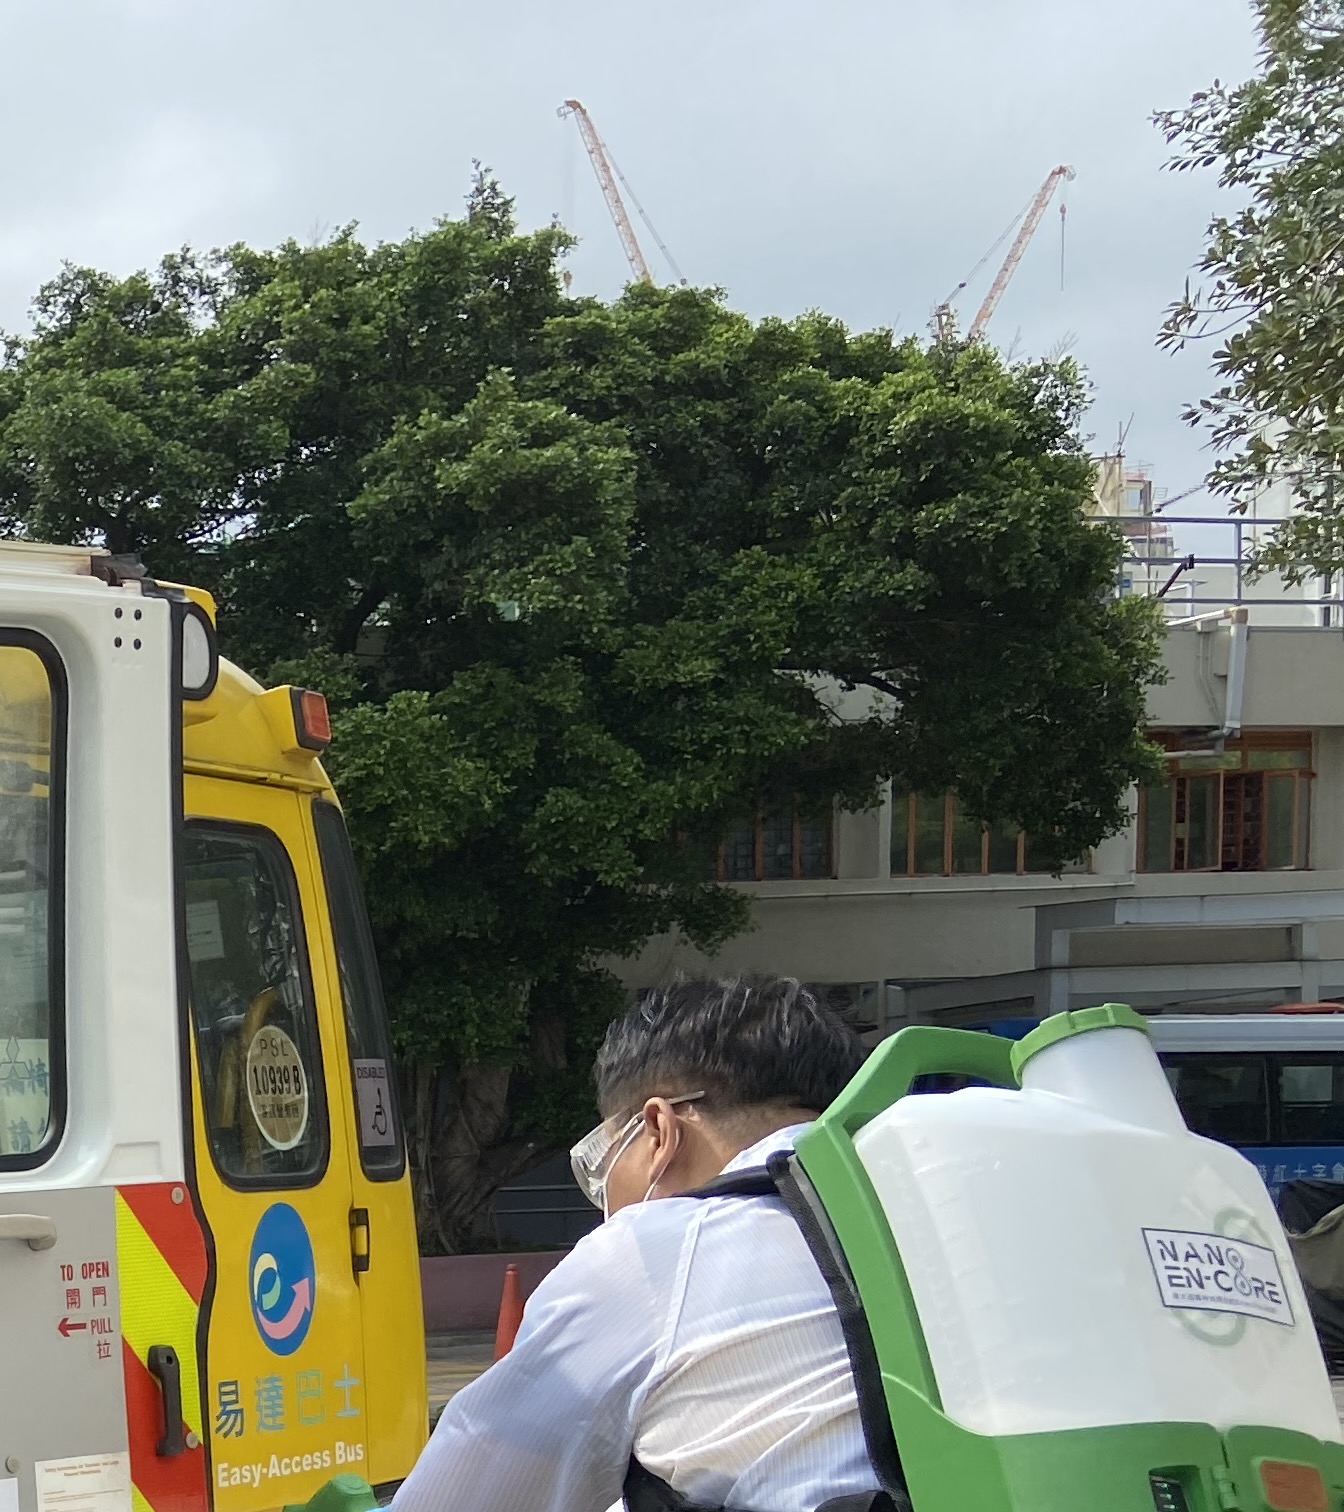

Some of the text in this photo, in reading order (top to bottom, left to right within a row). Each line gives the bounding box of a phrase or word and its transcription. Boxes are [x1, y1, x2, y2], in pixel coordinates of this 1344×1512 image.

[259, 1038, 289, 1057] PSL
[1156, 1239, 1244, 1272] NANO
[60, 1261, 110, 1281] TO OPEN
[1164, 1265, 1283, 1305] EN-CORE
[65, 1286, 107, 1311] 開門
[90, 1317, 114, 1336] PULL
[97, 1339, 112, 1360] 拉
[215, 1363, 361, 1439] 易達巴士
[217, 1440, 364, 1489] Easy-Access Bus
